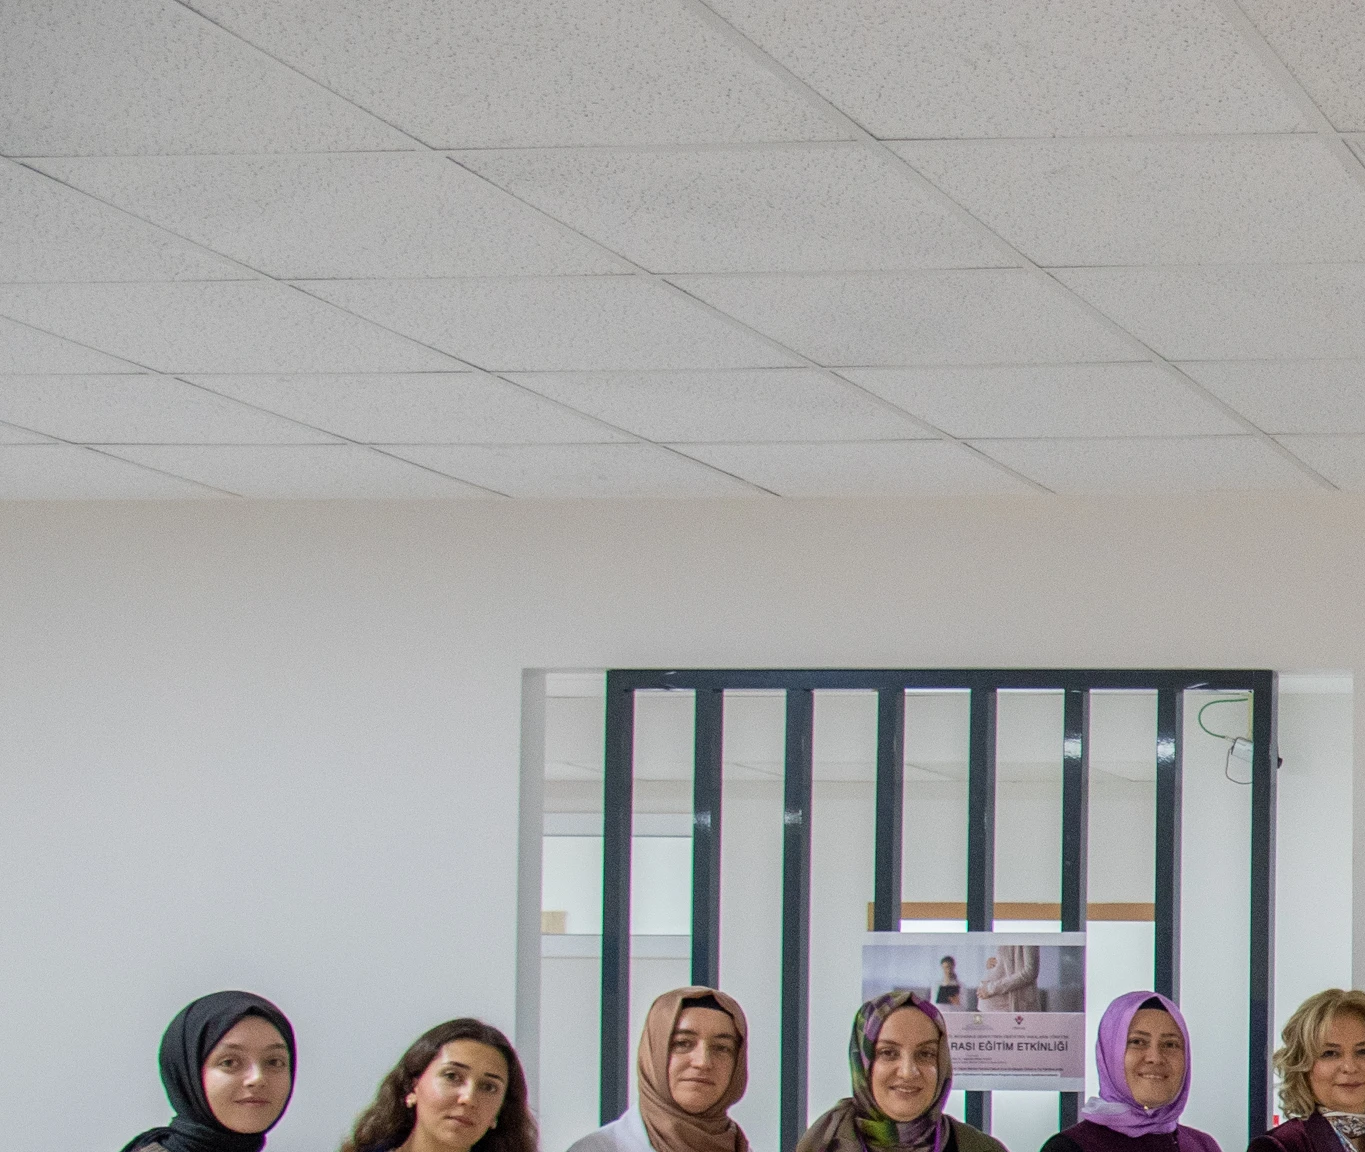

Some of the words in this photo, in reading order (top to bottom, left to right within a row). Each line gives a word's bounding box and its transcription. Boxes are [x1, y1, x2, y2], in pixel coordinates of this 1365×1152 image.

[950, 1041, 976, 1051] RASI
[978, 1040, 1014, 1051] EĞİTİM
[1016, 1040, 1068, 1051] ETKİNLİĞİ
